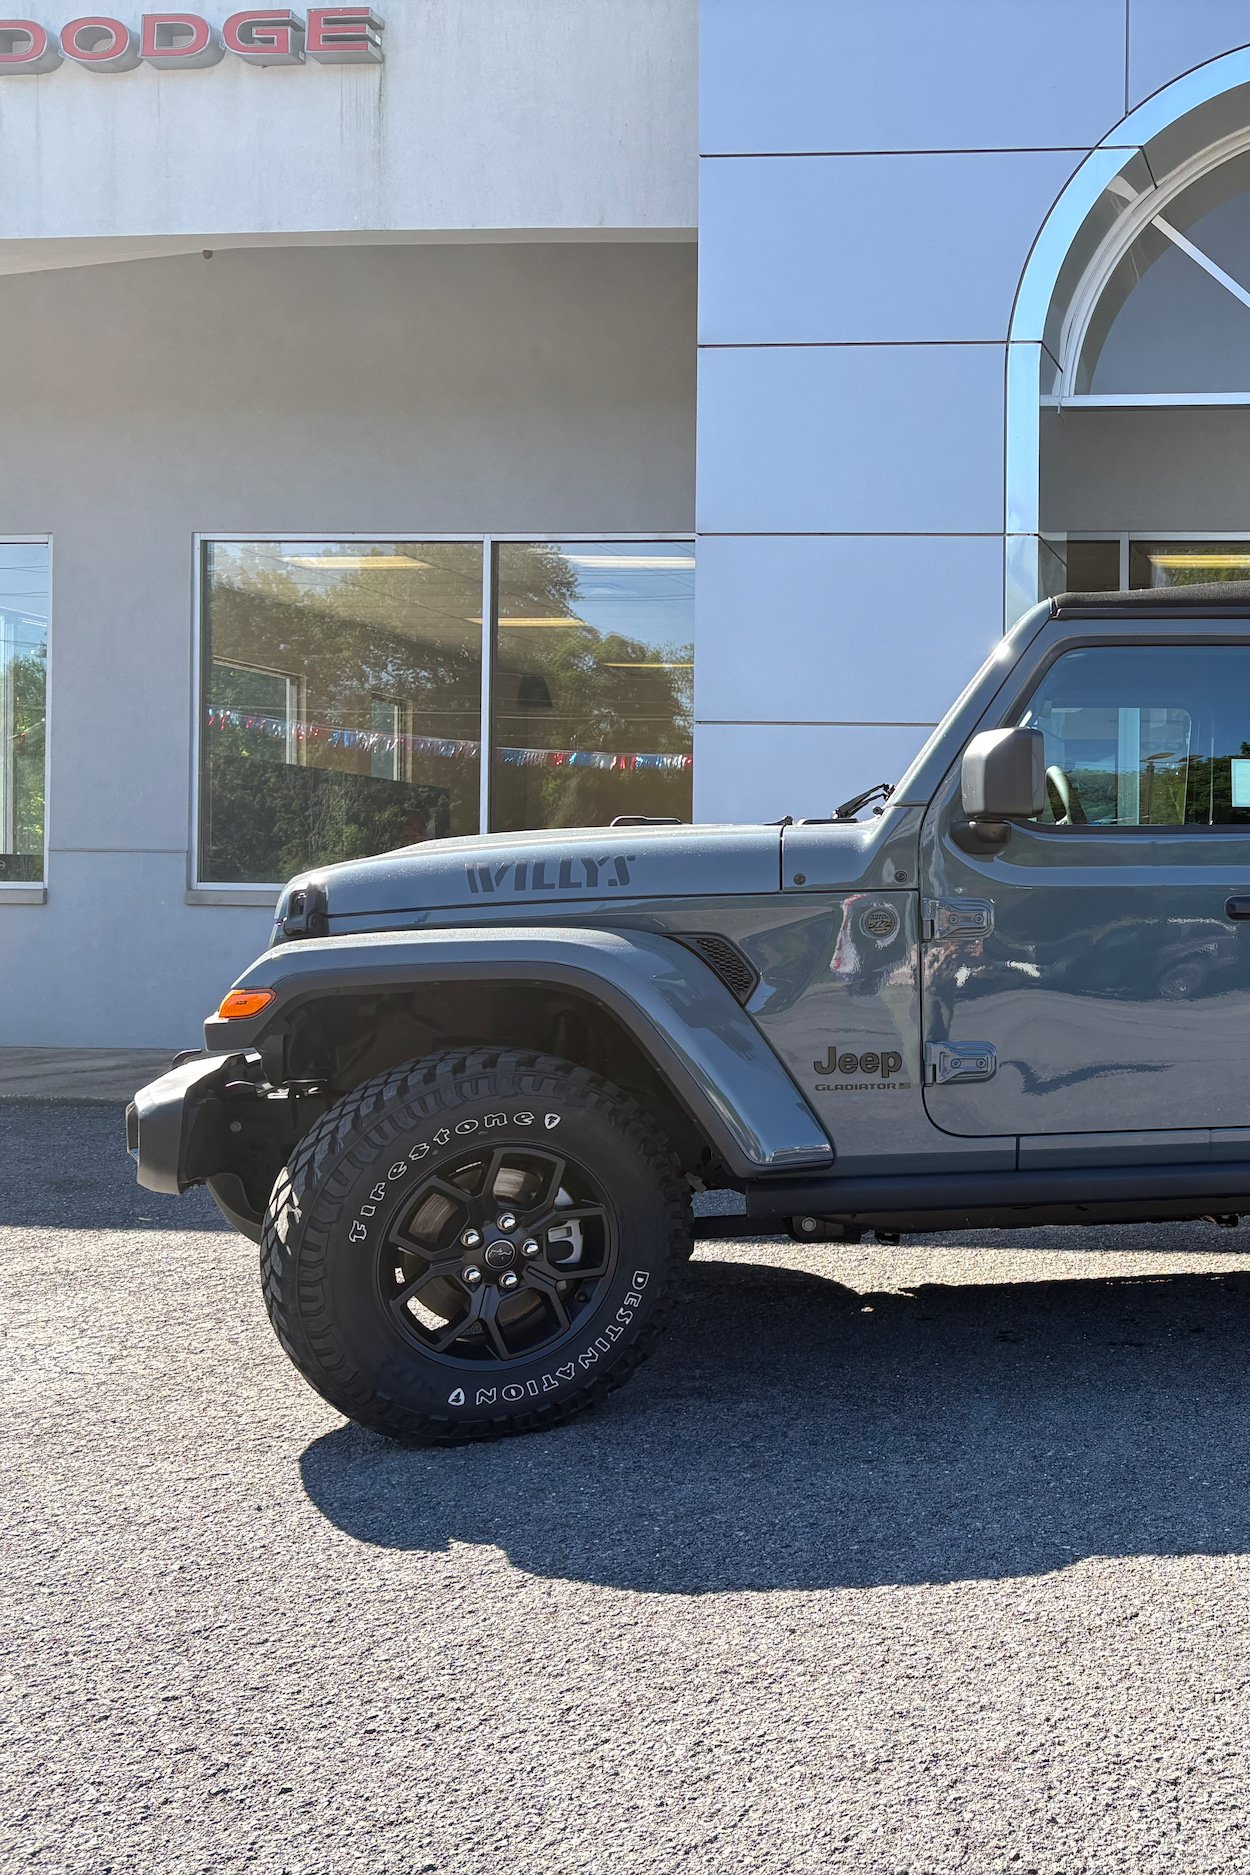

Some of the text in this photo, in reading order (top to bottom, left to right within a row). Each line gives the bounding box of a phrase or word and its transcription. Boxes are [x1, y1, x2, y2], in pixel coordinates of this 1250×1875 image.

[0, 7, 376, 66] DODGE
[465, 854, 637, 894] WILLYS
[813, 1046, 903, 1079] Jeep
[814, 1082, 897, 1092] GLADIATOR
[475, 1270, 650, 1406] DESTINATION
